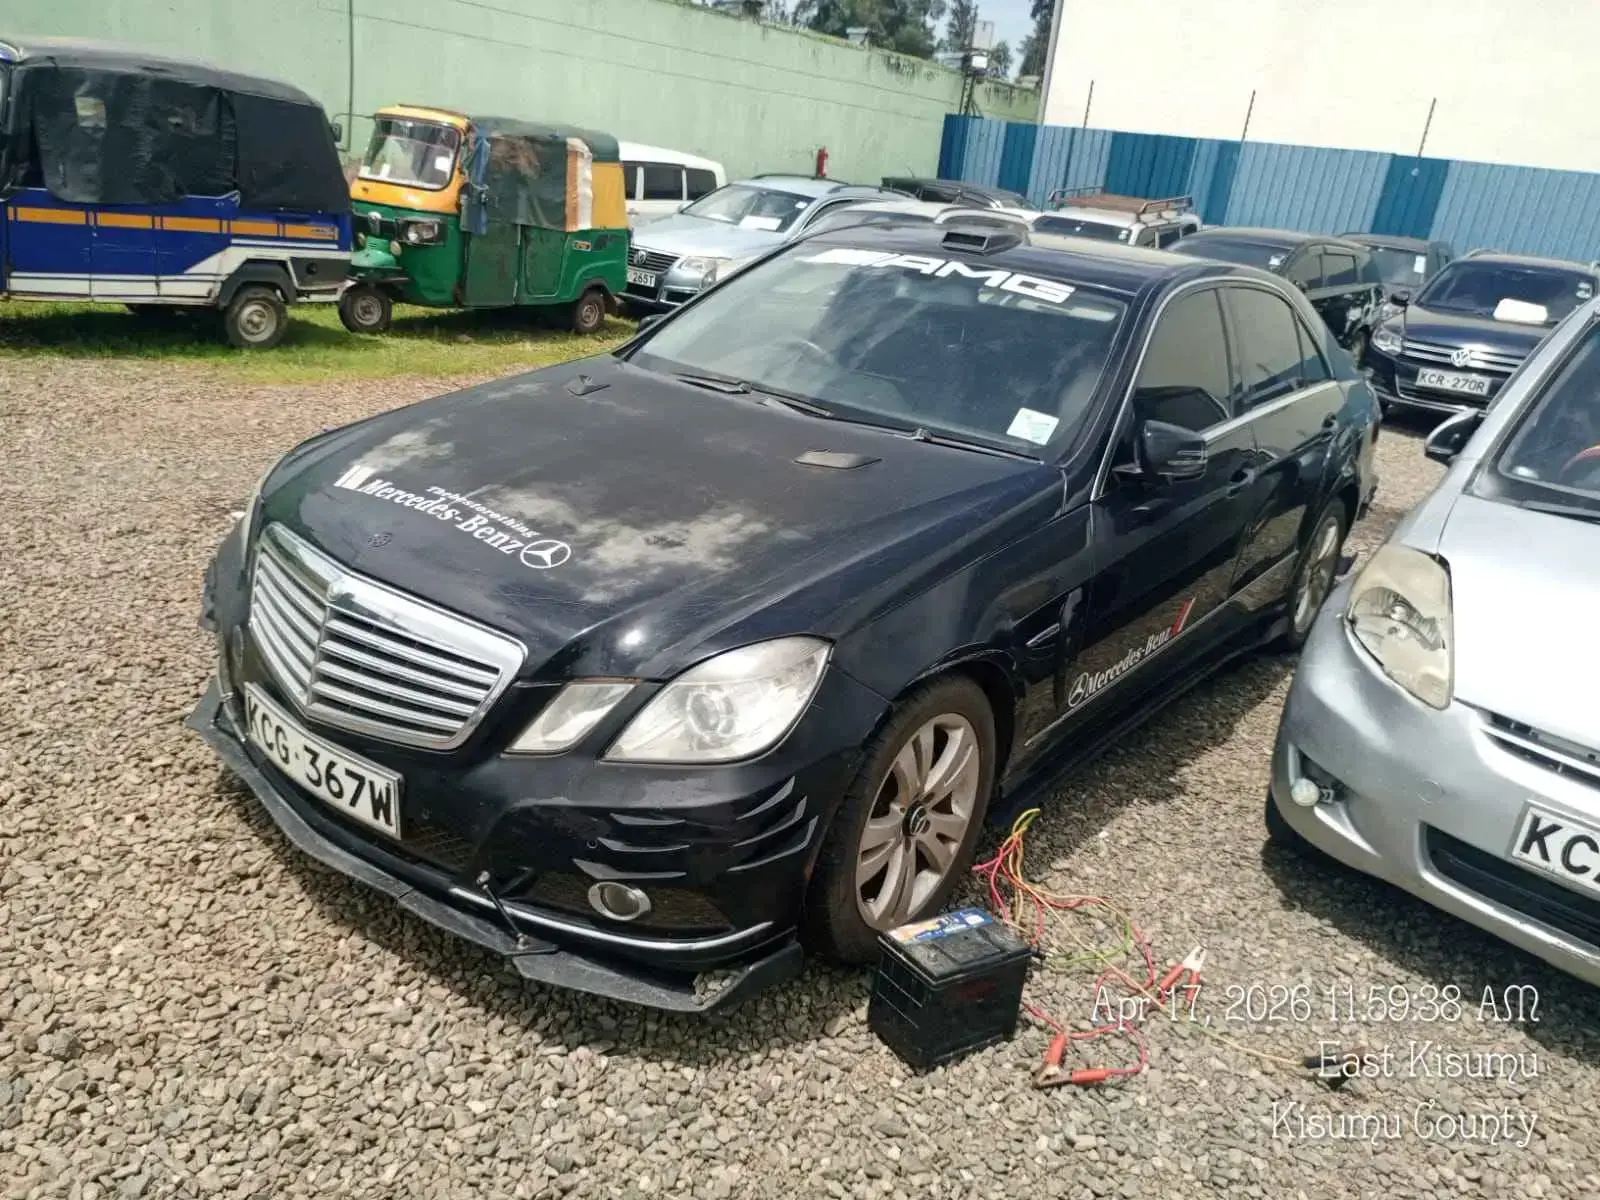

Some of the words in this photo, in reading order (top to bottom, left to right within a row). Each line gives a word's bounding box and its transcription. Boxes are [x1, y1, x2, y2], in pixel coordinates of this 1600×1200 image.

[359, 478, 525, 554] Mercedes-Benz
[1083, 626, 1172, 699] Mercedes-Benz
[1520, 814, 1600, 884] KC
